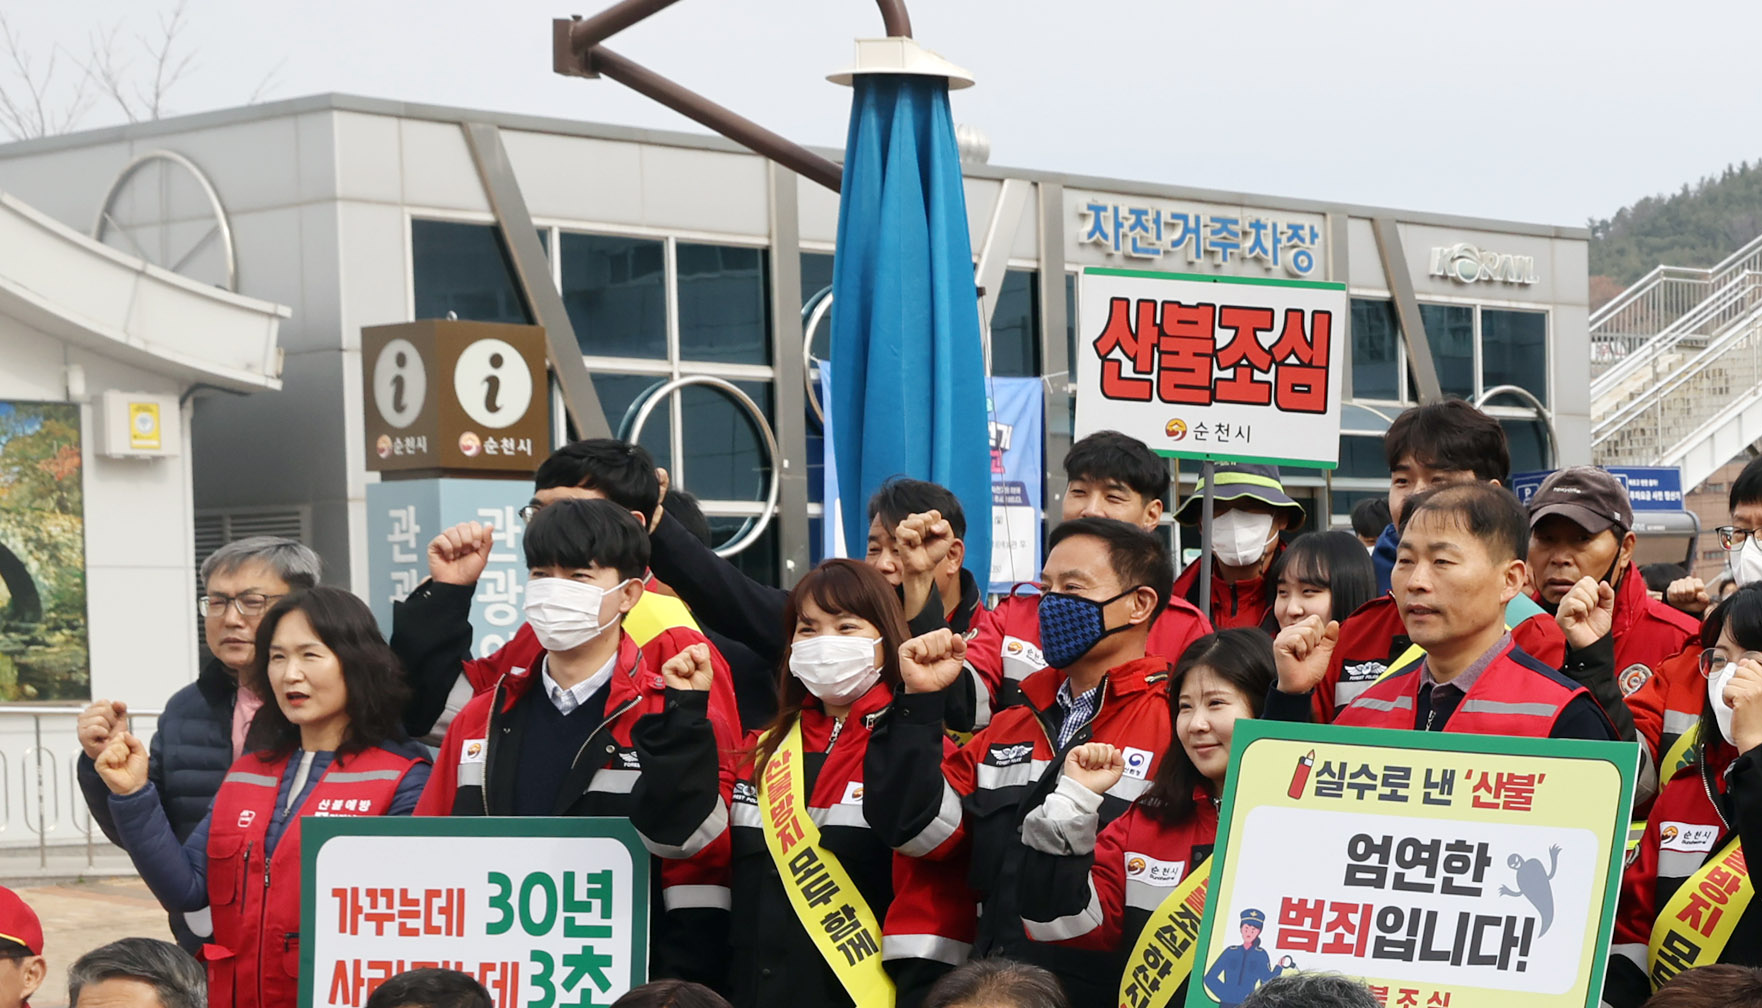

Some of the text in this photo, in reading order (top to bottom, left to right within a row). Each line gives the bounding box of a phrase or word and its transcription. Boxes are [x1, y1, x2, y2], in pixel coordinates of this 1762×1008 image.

[1086, 202, 1320, 274] 자전거주차장
[1429, 242, 1540, 285] KORAIL
[1092, 296, 1333, 415] 산불조심
[484, 437, 533, 457] 순천시
[1193, 420, 1252, 444] 순천시
[1314, 760, 1413, 803] 실수로
[1422, 767, 1456, 807] 낸
[764, 748, 880, 968] 산불방지 모두 함께
[1343, 832, 1493, 898] 엄연한
[331, 868, 614, 939] 가꾸는데 30년
[1275, 895, 1537, 974] 범죄입니다!
